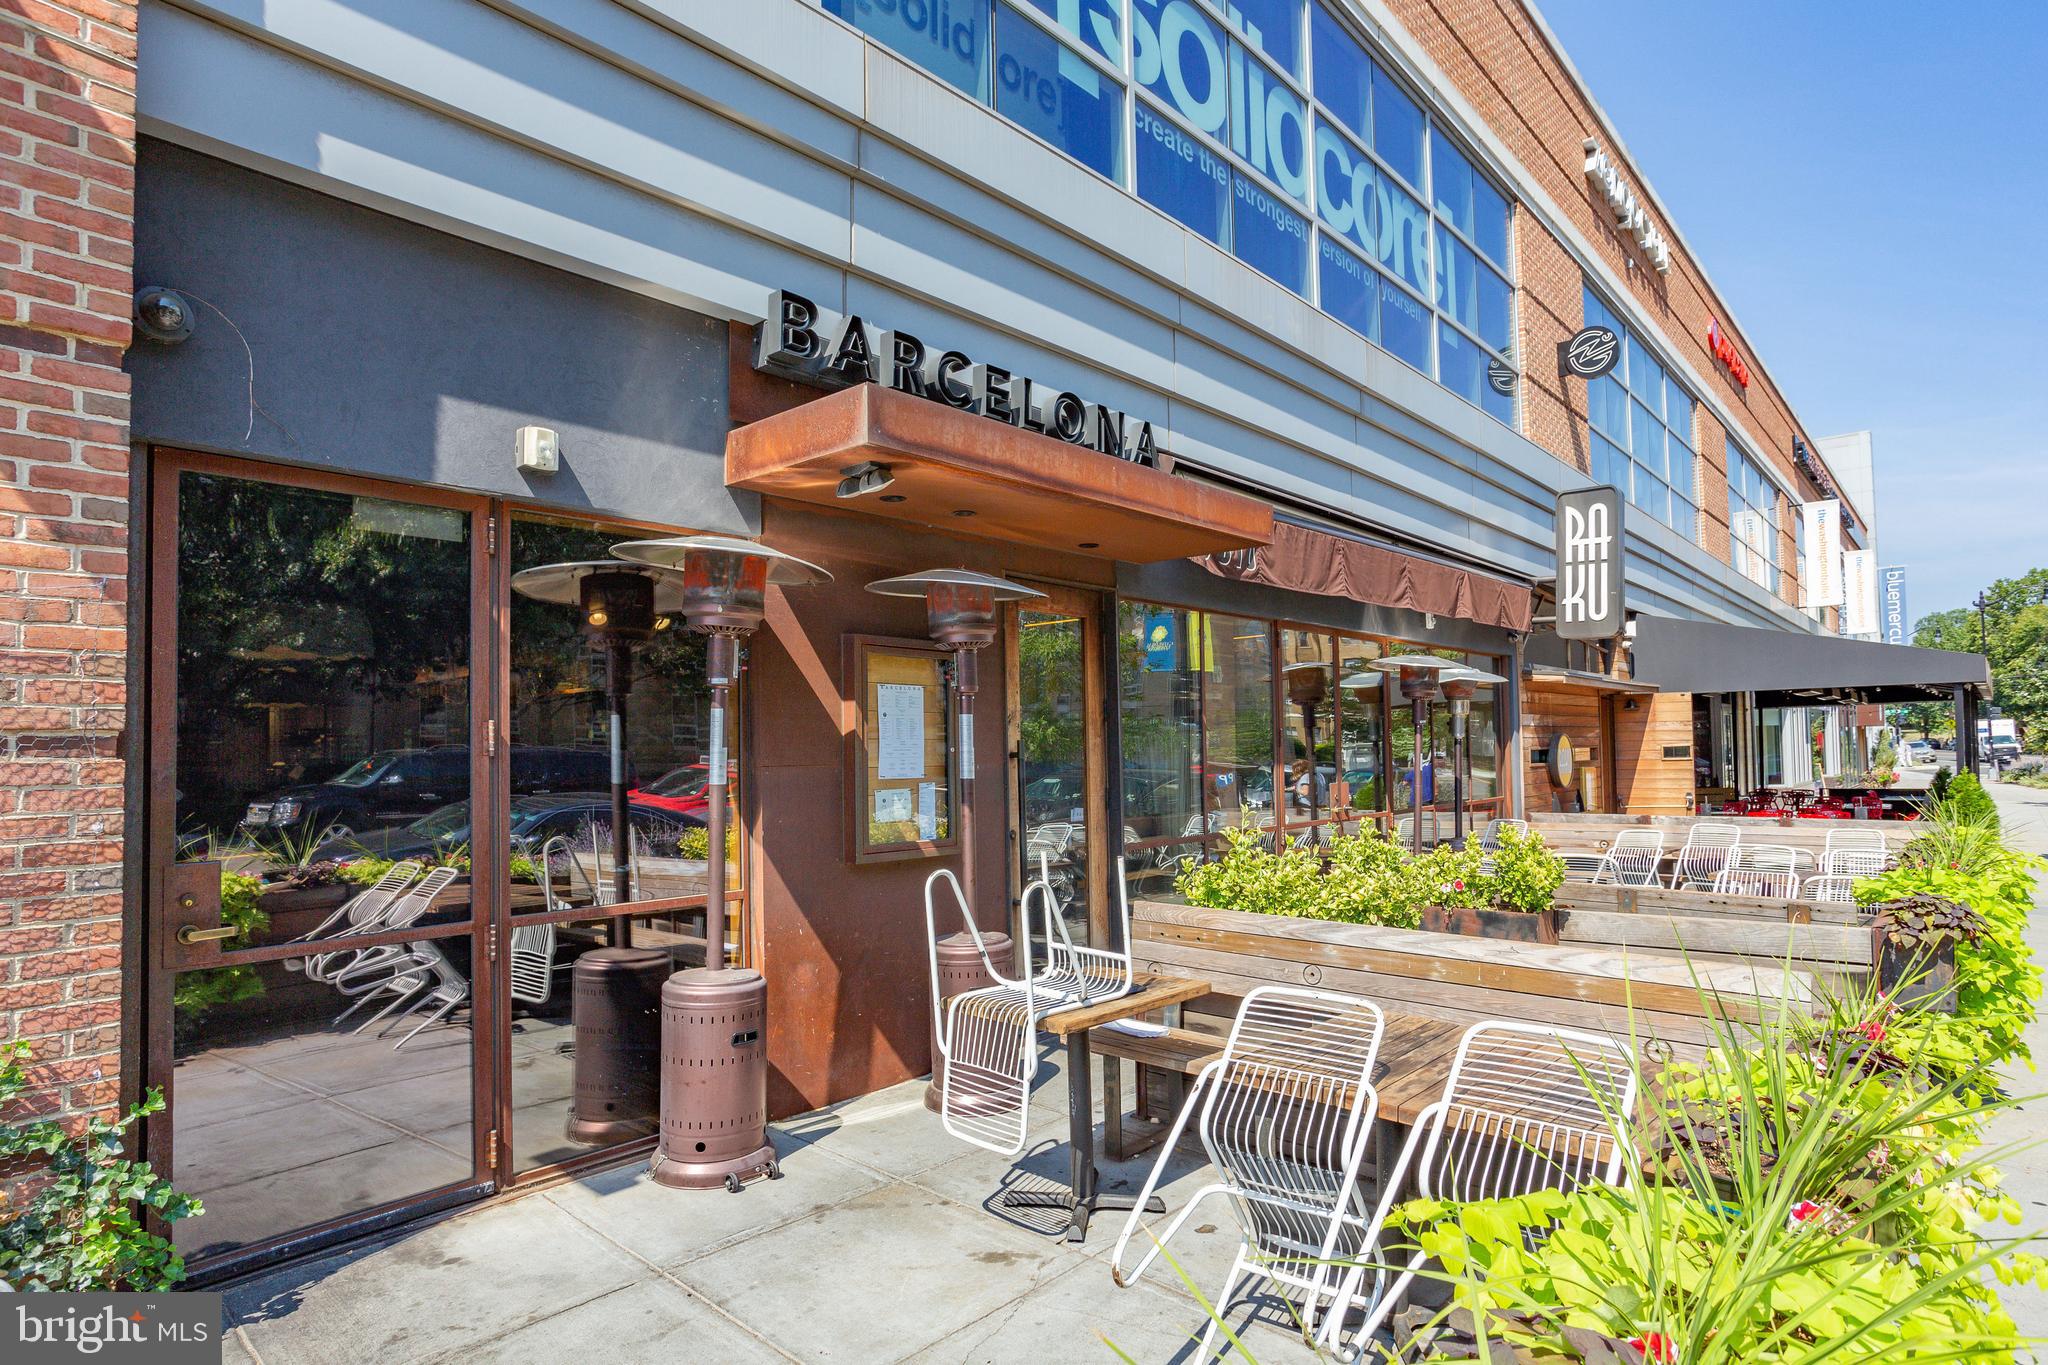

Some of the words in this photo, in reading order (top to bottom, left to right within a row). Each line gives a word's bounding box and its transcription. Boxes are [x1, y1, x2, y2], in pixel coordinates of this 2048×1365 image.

[1135, 107, 1194, 163] create
[1199, 147, 1227, 186] the
[1235, 178, 1307, 242] strongest
[1319, 238, 1361, 280] ersion
[1382, 283, 1421, 321] yourself
[767, 288, 1161, 471] BARCELONA
[1886, 570, 1905, 645] bluemercu
